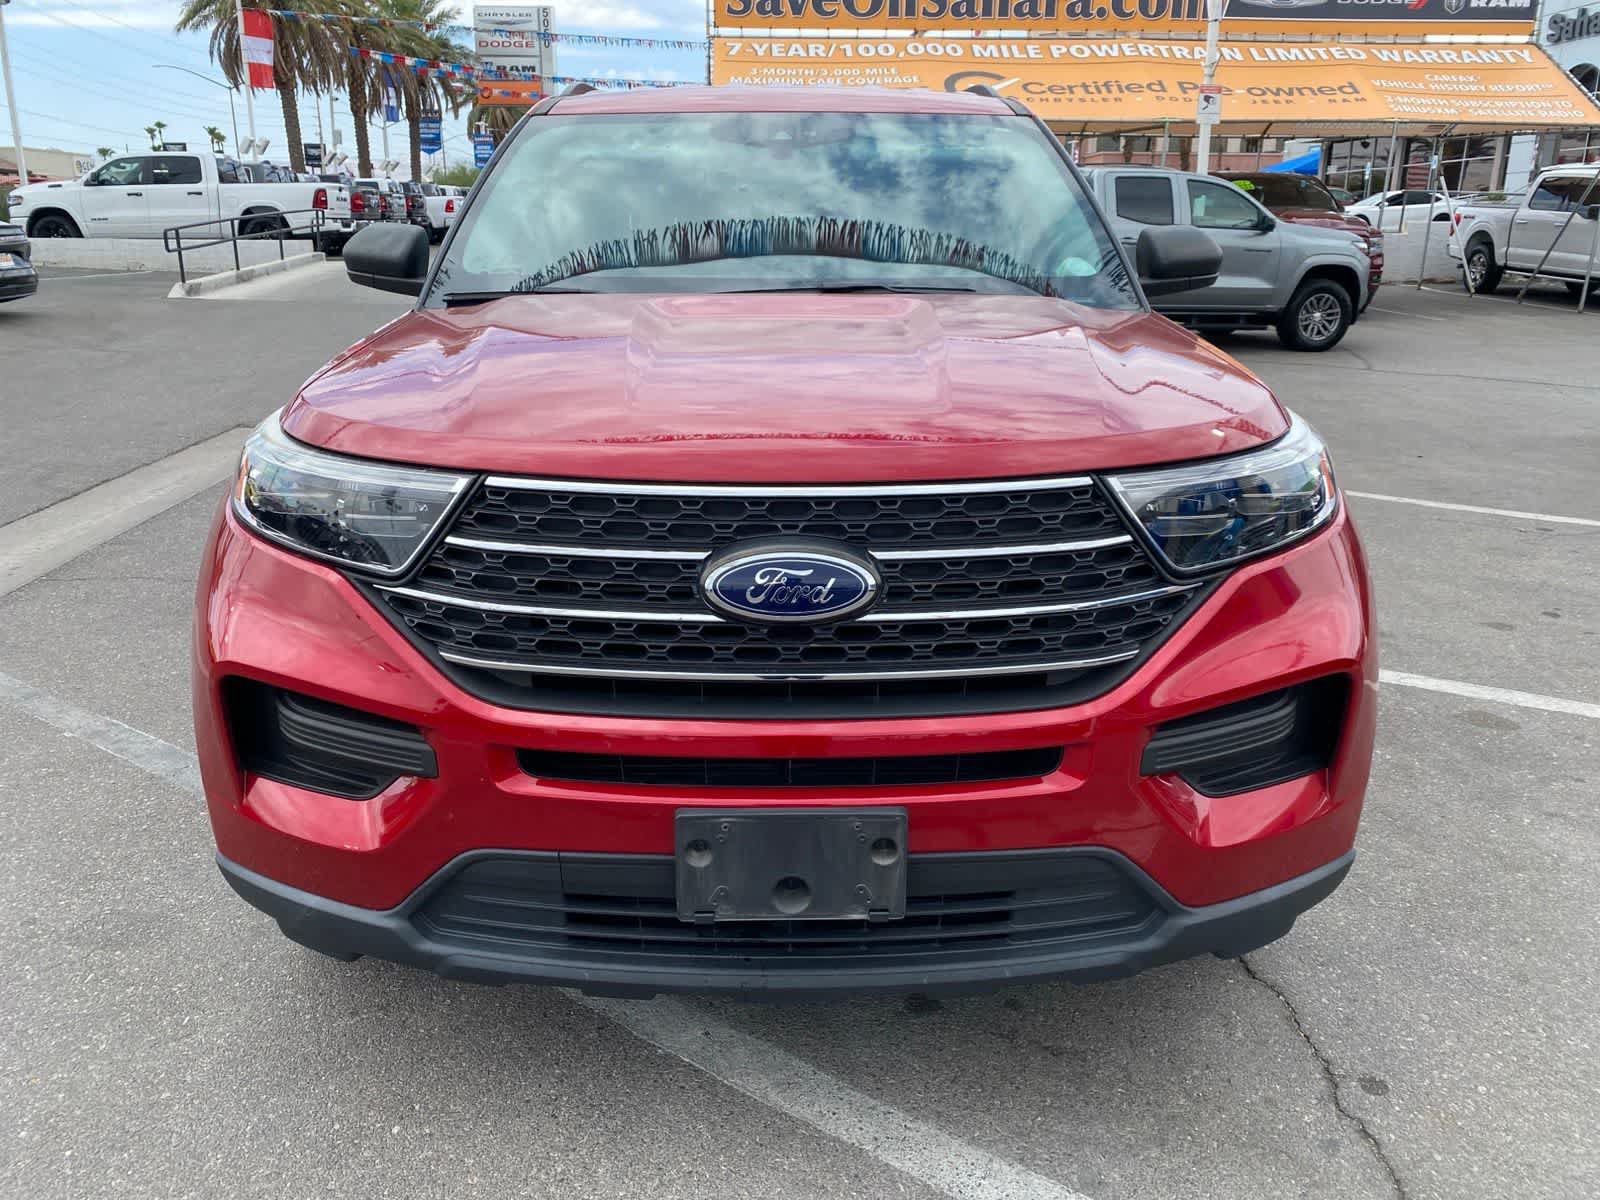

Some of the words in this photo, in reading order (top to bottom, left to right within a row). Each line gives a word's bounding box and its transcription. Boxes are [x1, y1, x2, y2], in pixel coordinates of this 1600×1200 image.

[478, 40, 536, 48] DODGE
[726, 42, 964, 58] 7-YEAR/100,000
[972, 43, 1043, 59] MILE
[1249, 47, 1368, 62] LIMITED
[1370, 48, 1533, 64] WARRANTY
[495, 65, 536, 73] RAM
[848, 75, 920, 85] COVERAGE
[1021, 80, 1167, 96] Certified
[745, 567, 837, 605] Ford
